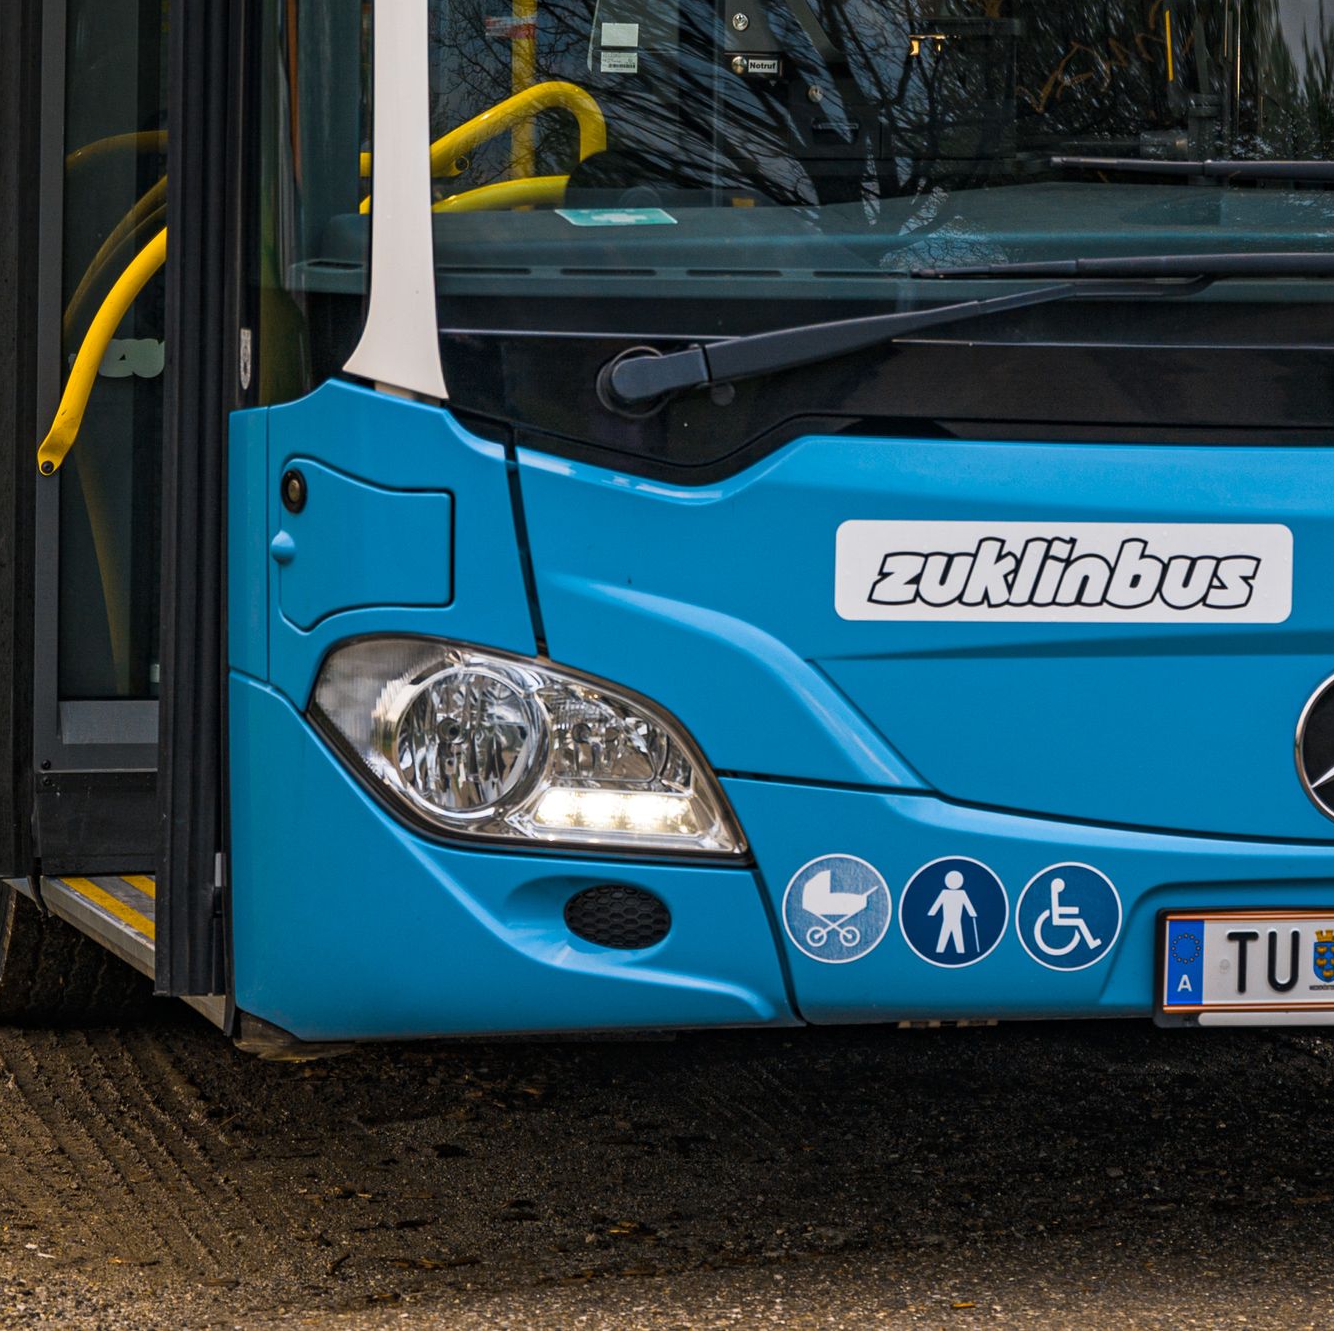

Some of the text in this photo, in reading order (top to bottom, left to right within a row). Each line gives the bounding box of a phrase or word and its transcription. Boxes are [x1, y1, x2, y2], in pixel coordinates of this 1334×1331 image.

[749, 59, 776, 71] Notruf
[867, 536, 1263, 611] zuklinbus
[1226, 930, 1301, 994] TU
[1177, 974, 1193, 992] A
